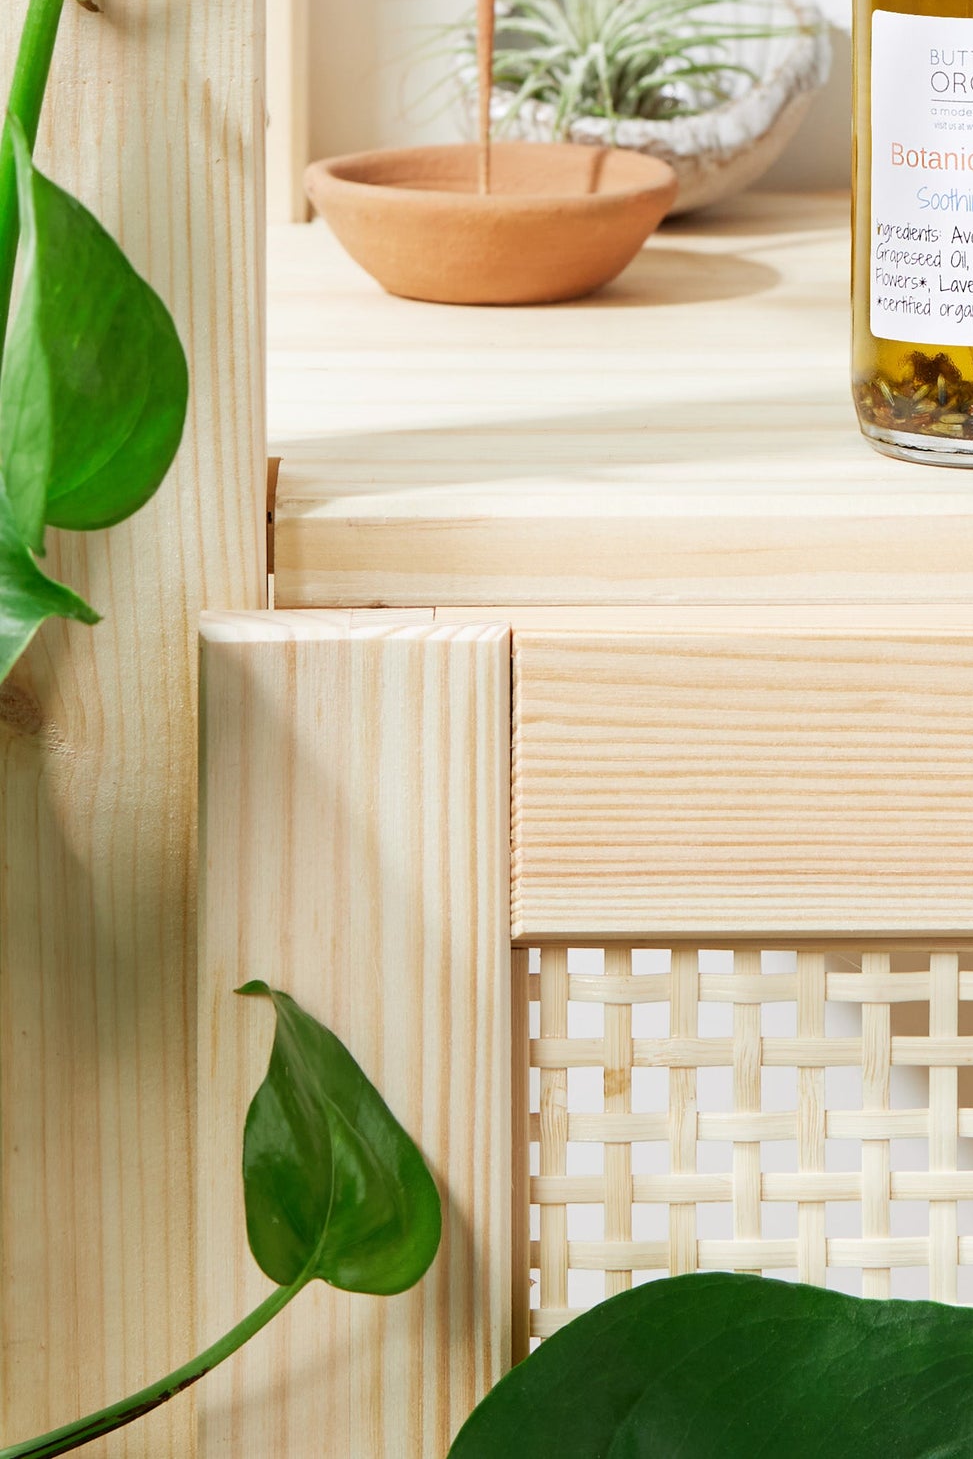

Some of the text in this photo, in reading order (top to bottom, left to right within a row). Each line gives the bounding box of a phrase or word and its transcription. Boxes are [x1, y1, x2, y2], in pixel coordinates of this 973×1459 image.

[930, 108, 938, 117] a
[934, 121, 948, 131] visit
[957, 122, 965, 131] at
[876, 242, 942, 269] Grapeseed
[951, 250, 970, 271] Oil,
